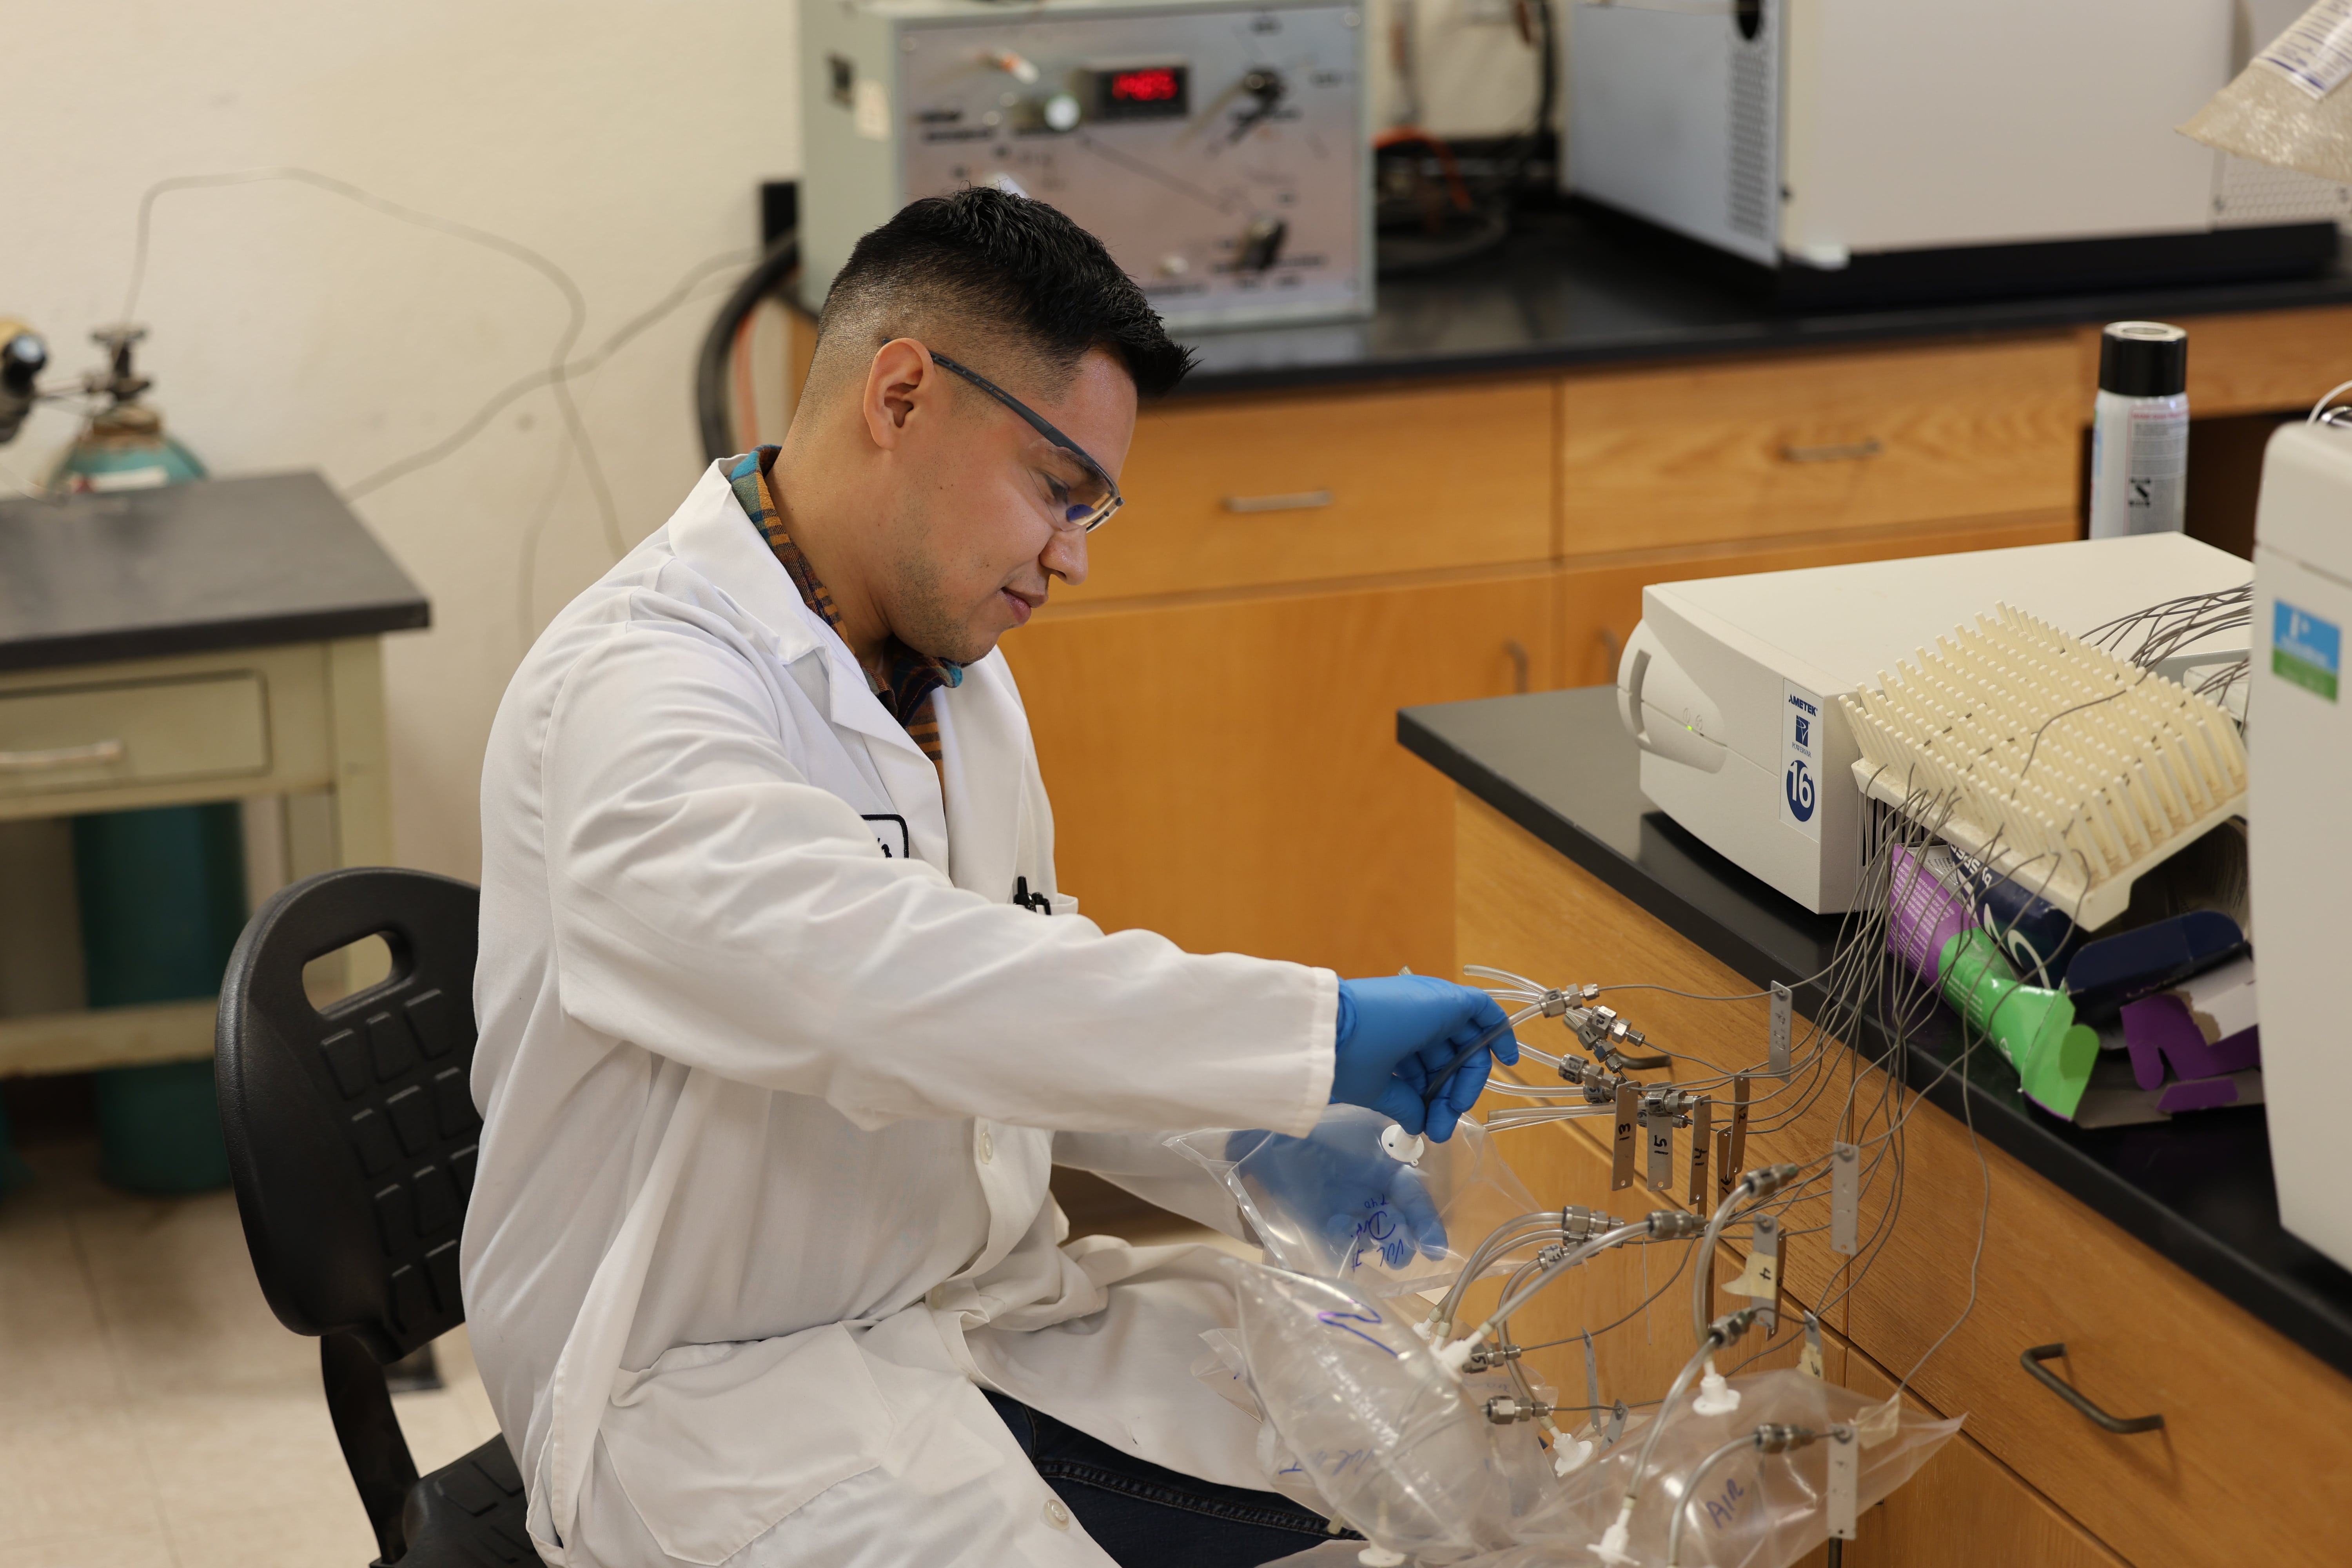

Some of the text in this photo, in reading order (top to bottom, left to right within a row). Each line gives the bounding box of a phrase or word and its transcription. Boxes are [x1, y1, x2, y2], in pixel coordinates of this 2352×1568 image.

[1789, 694, 1817, 717] AMETEK
[1792, 742, 1811, 758] POWERVAR
[1789, 761, 1812, 808] 16
[1618, 1123, 1631, 1141] 13
[1654, 1134, 1669, 1155] 15
[1706, 1478, 1745, 1531] AIR
